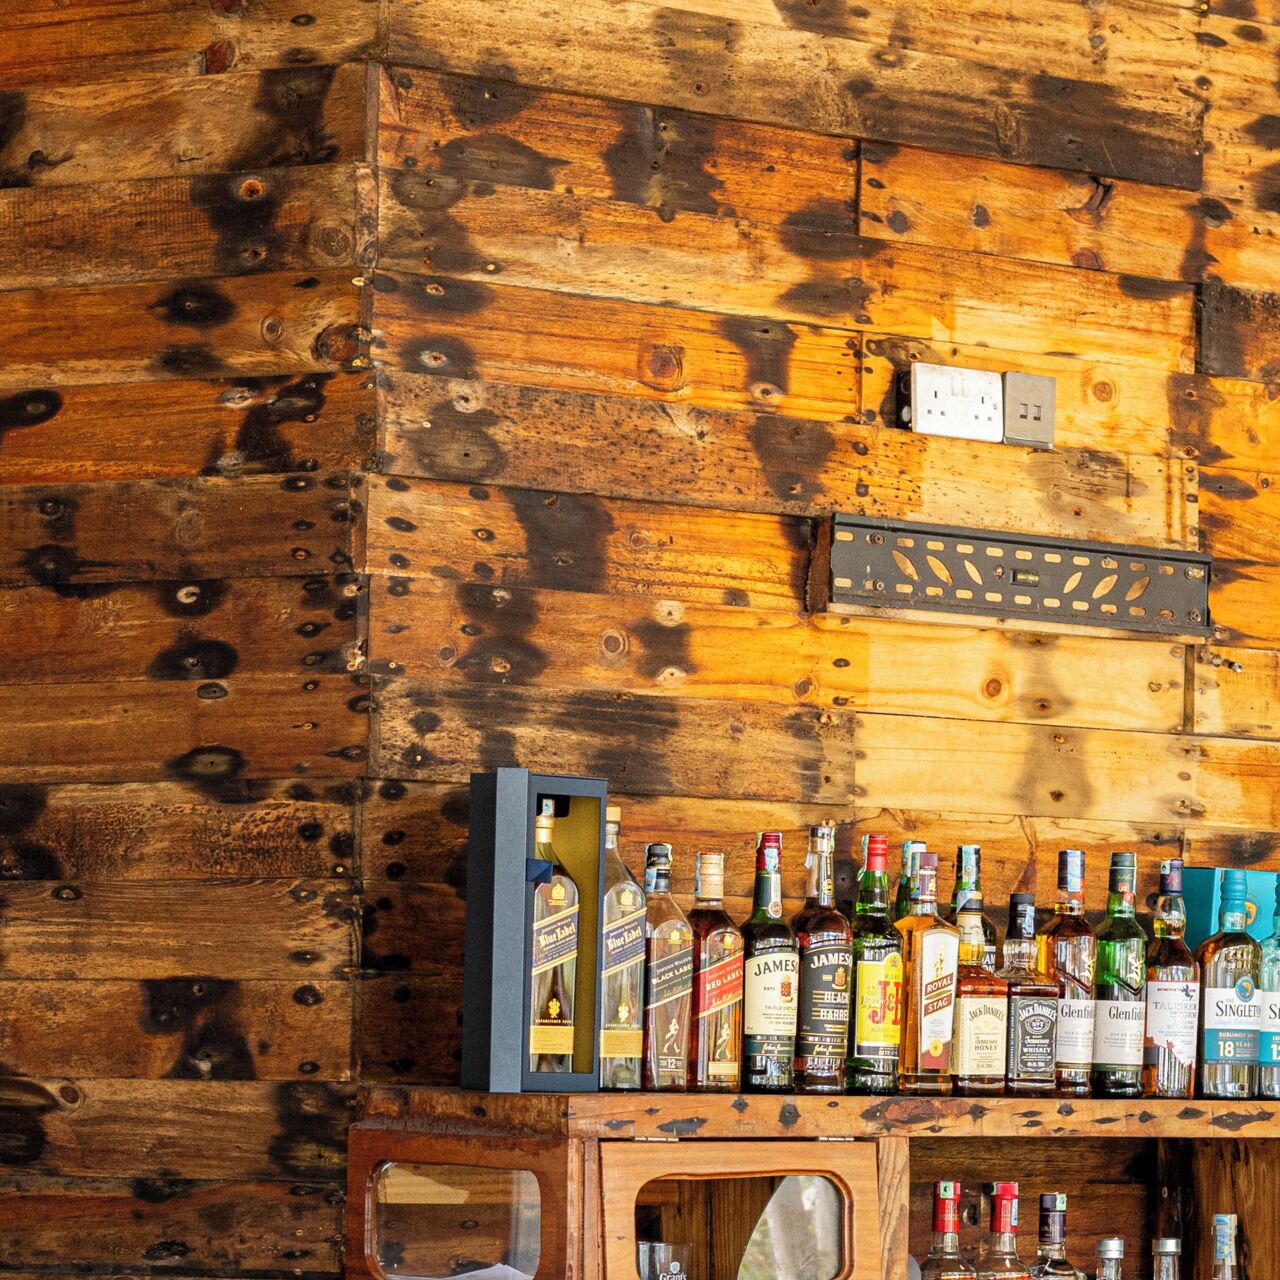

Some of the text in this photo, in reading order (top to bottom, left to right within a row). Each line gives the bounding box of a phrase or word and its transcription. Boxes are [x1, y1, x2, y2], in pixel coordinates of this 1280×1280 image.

[539, 923, 576, 947] Blue Label
[606, 927, 642, 951] Blue Label
[652, 971, 674, 985] BLACK
[705, 980, 722, 991] RED
[927, 976, 953, 993] ROYAL
[928, 997, 948, 1012] STAG
[969, 1007, 983, 1022] JACK
[1019, 1006, 1034, 1021] JACK
[1218, 1041, 1234, 1057] 18
[667, 1059, 677, 1069] 12
